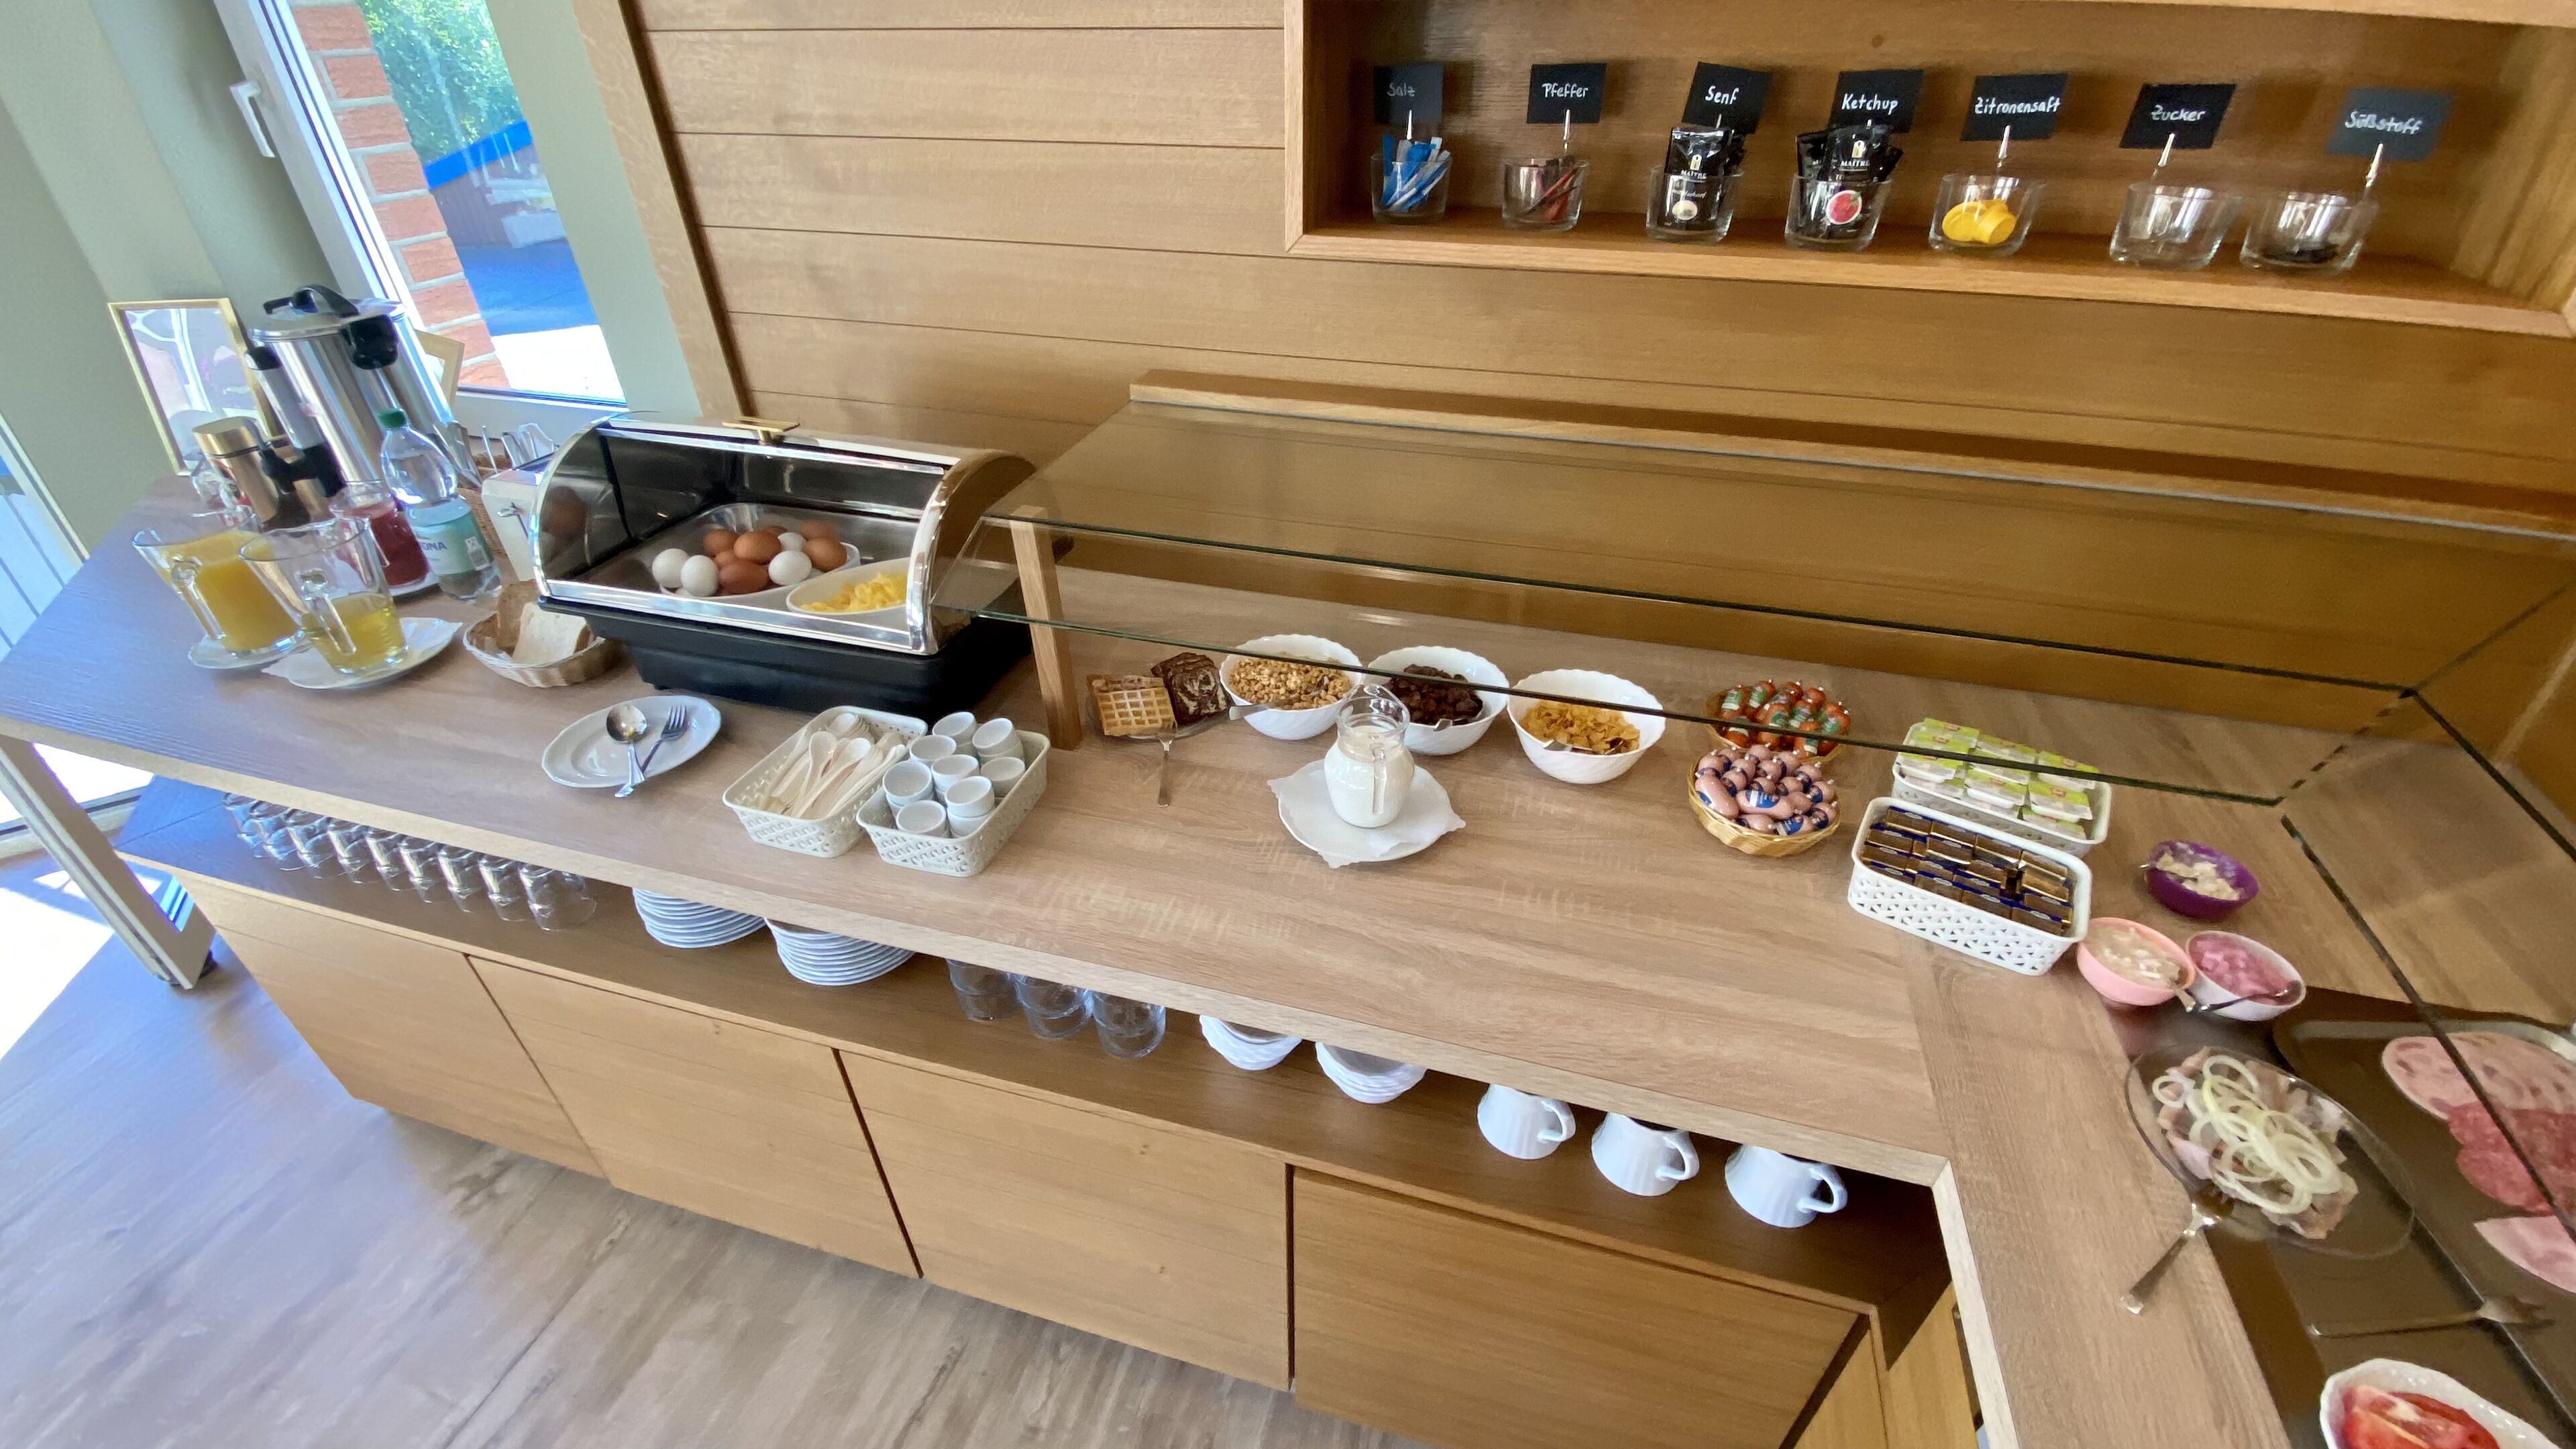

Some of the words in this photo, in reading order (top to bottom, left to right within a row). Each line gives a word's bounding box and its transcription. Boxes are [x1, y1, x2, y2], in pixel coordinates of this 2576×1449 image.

[1387, 82, 1415, 97] Salz
[1542, 83, 1589, 98] Pfeffer
[1705, 85, 1739, 105] Senf
[1841, 93, 1898, 115] Ketchup
[1974, 96, 2061, 115] Zitronensaft
[2151, 105, 2206, 121] Zucker
